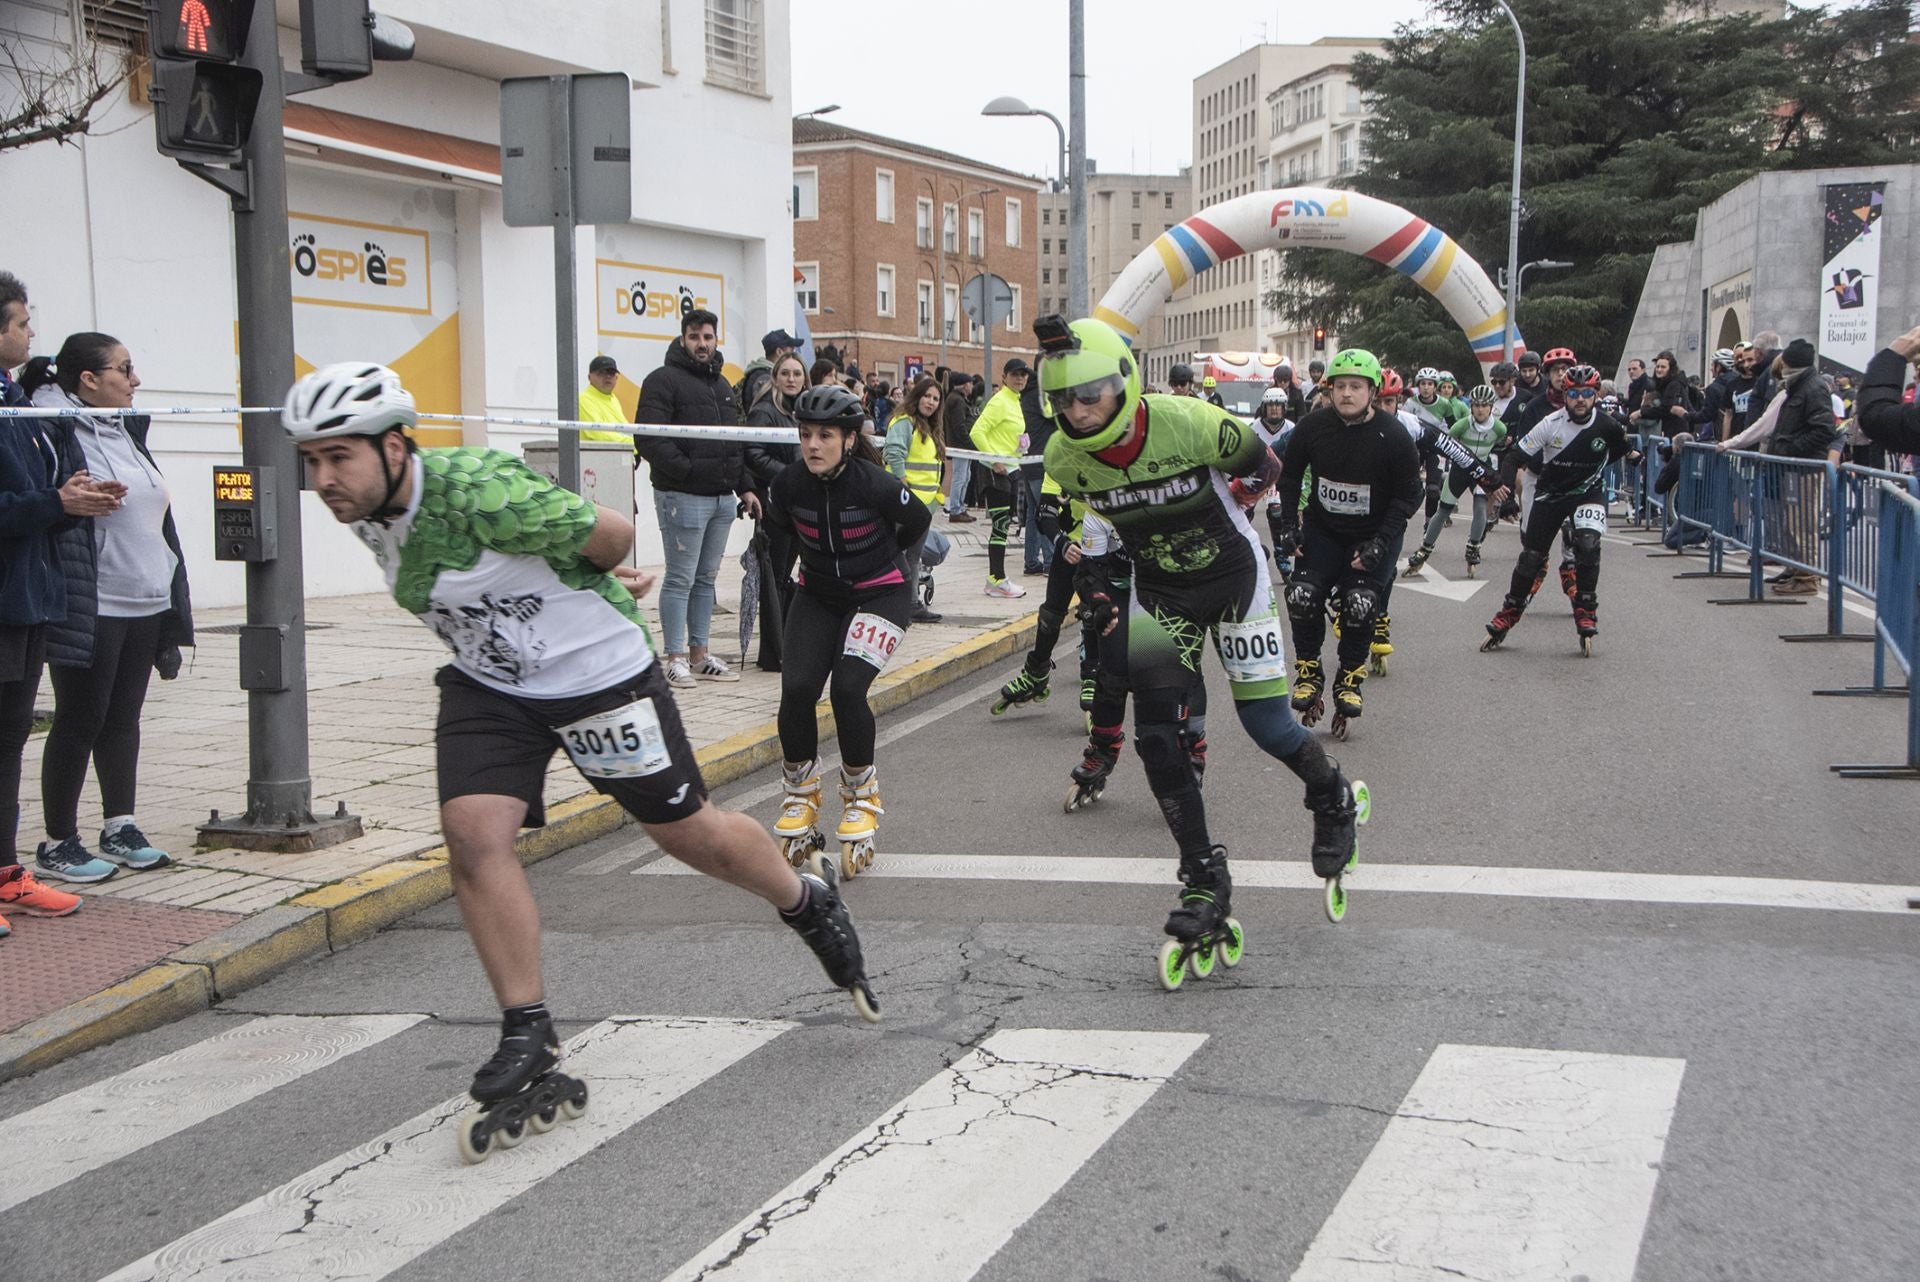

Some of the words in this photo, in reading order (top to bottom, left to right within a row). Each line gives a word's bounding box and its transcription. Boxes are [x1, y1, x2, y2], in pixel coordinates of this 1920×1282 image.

[1828, 319, 1857, 328] Carnaval
[1827, 329, 1868, 346] Badajoz
[1320, 485, 1358, 503] 3005
[851, 621, 897, 656] 3116
[1223, 631, 1279, 661] 3006
[568, 722, 641, 755] 3015
